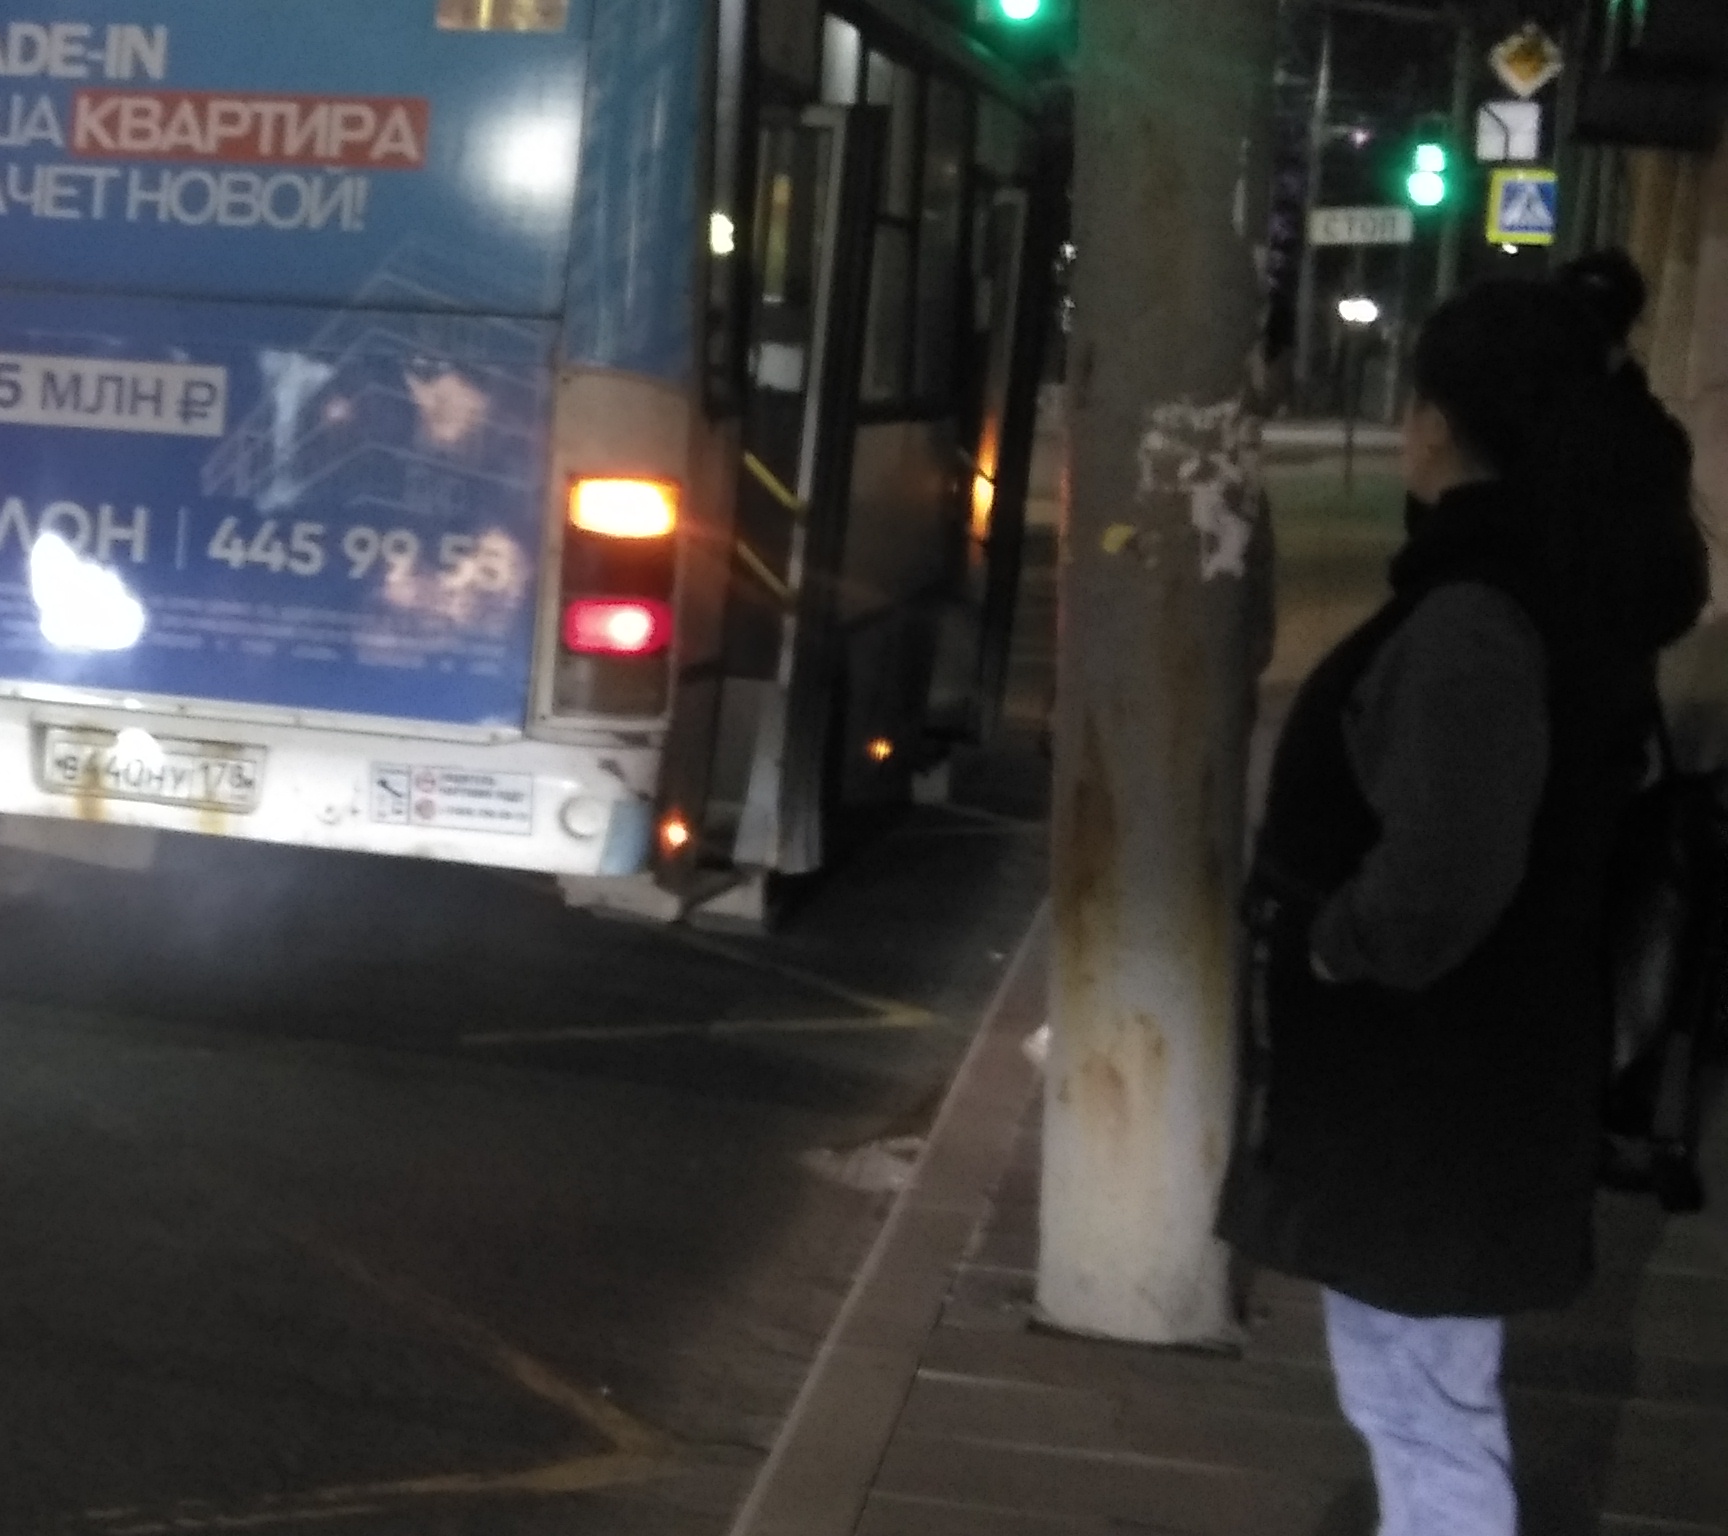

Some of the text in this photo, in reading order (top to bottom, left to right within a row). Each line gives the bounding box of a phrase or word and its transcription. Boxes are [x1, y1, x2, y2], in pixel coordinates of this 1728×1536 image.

[74, 94, 420, 161] КВАРТИРА
[125, 164, 370, 233] НОВОЙ!
[207, 515, 327, 578] 445
[342, 525, 421, 586] 99
